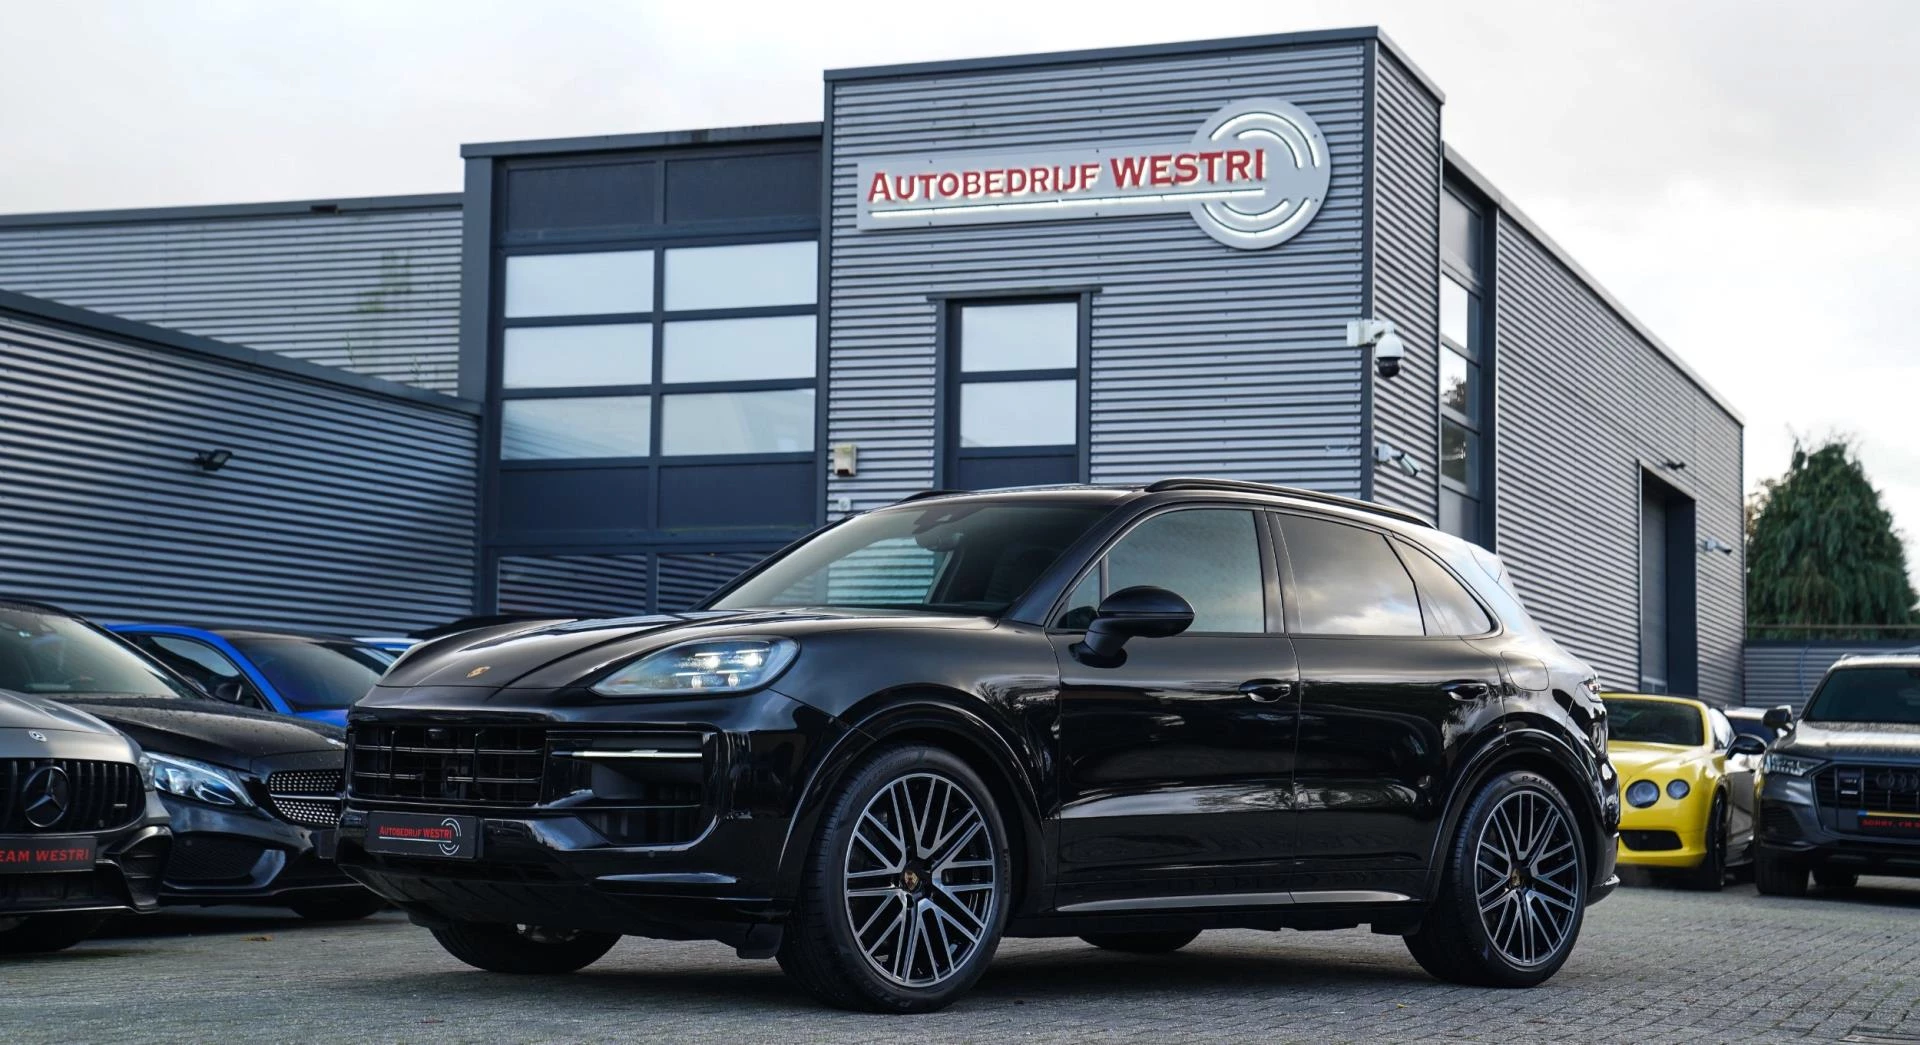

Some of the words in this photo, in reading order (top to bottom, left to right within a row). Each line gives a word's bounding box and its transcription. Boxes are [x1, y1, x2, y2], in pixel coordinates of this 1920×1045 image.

[867, 163, 1101, 202] AUTOBEDRIJF
[1110, 148, 1266, 189] WESTRI
[379, 825, 422, 837] AUTOBEDRIJF
[423, 828, 452, 839] WESTRI
[0, 849, 30, 862] EAM
[36, 847, 89, 862] WESTRI
